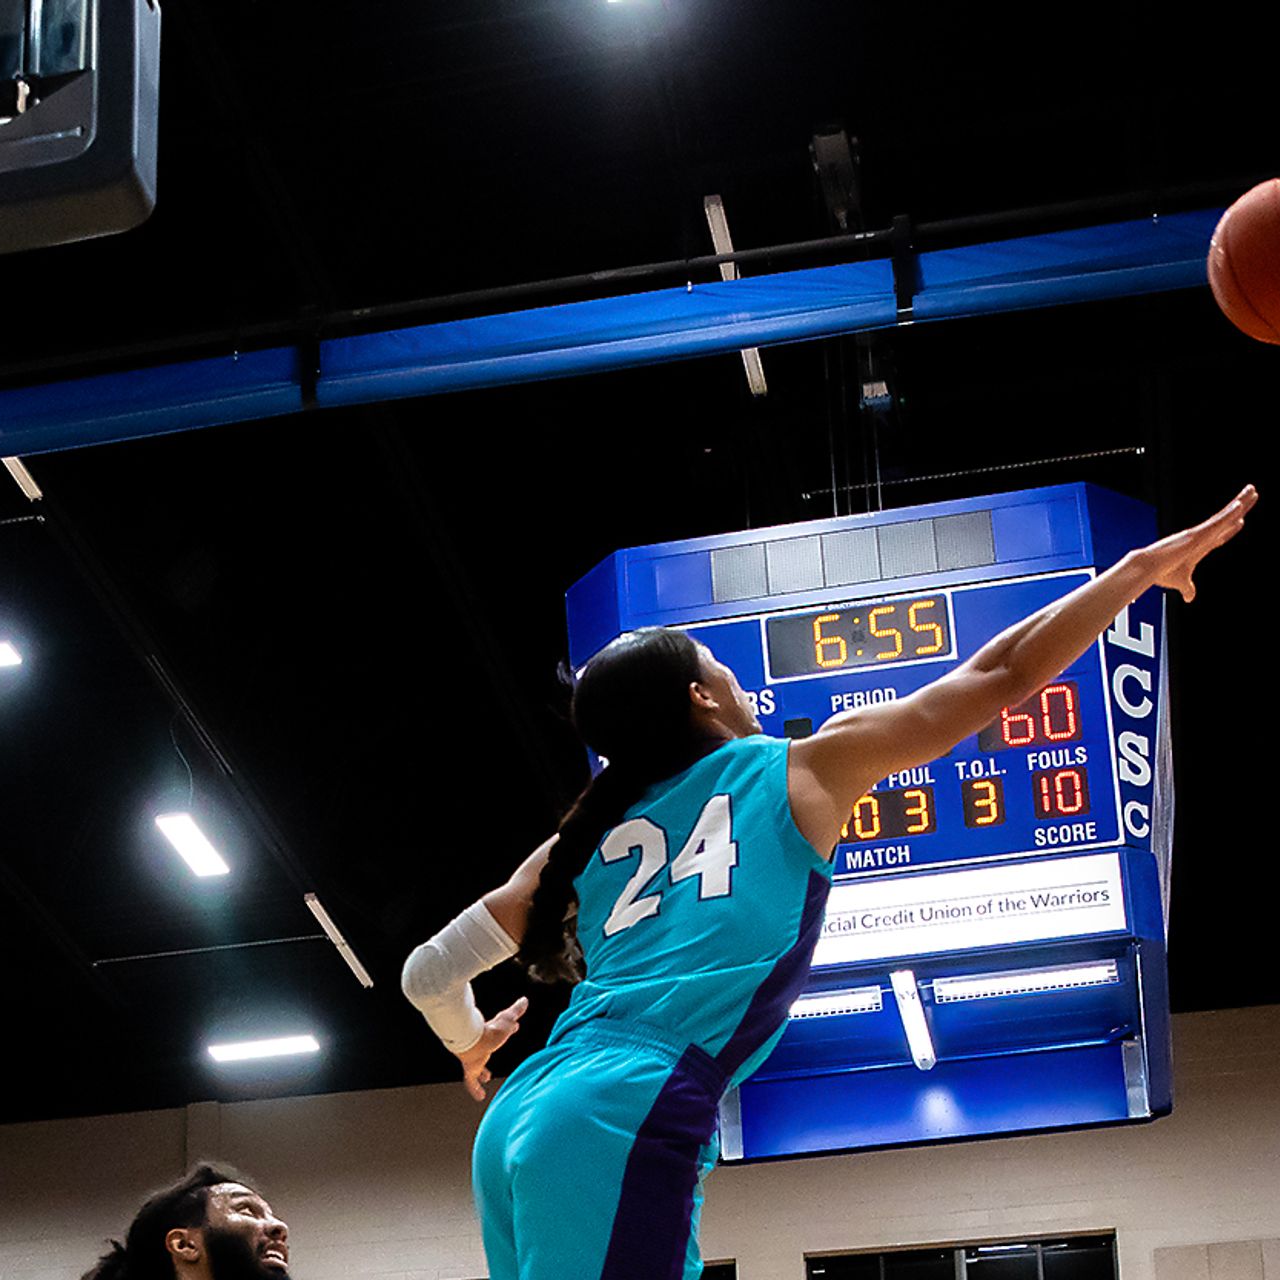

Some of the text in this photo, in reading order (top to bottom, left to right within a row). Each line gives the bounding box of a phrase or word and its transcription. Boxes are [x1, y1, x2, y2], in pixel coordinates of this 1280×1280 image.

[814, 600, 944, 667] 6:55
[831, 688, 896, 712] PERIOD
[1002, 685, 1076, 745] 60
[889, 767, 935, 788] FOUL
[955, 759, 1007, 780] T.O.L.
[1027, 747, 1088, 770] FOULS
[972, 781, 998, 825] 3
[1040, 771, 1082, 813] 10
[841, 789, 929, 839] 0 3
[1035, 822, 1097, 846] SCORE
[599, 794, 738, 939] 24
[846, 845, 910, 869] MATCH
[861, 911, 915, 929] Credit
[920, 904, 972, 922] Union
[976, 900, 993, 915] of
[998, 896, 1027, 913] the
[1029, 888, 1110, 910] Warriors
